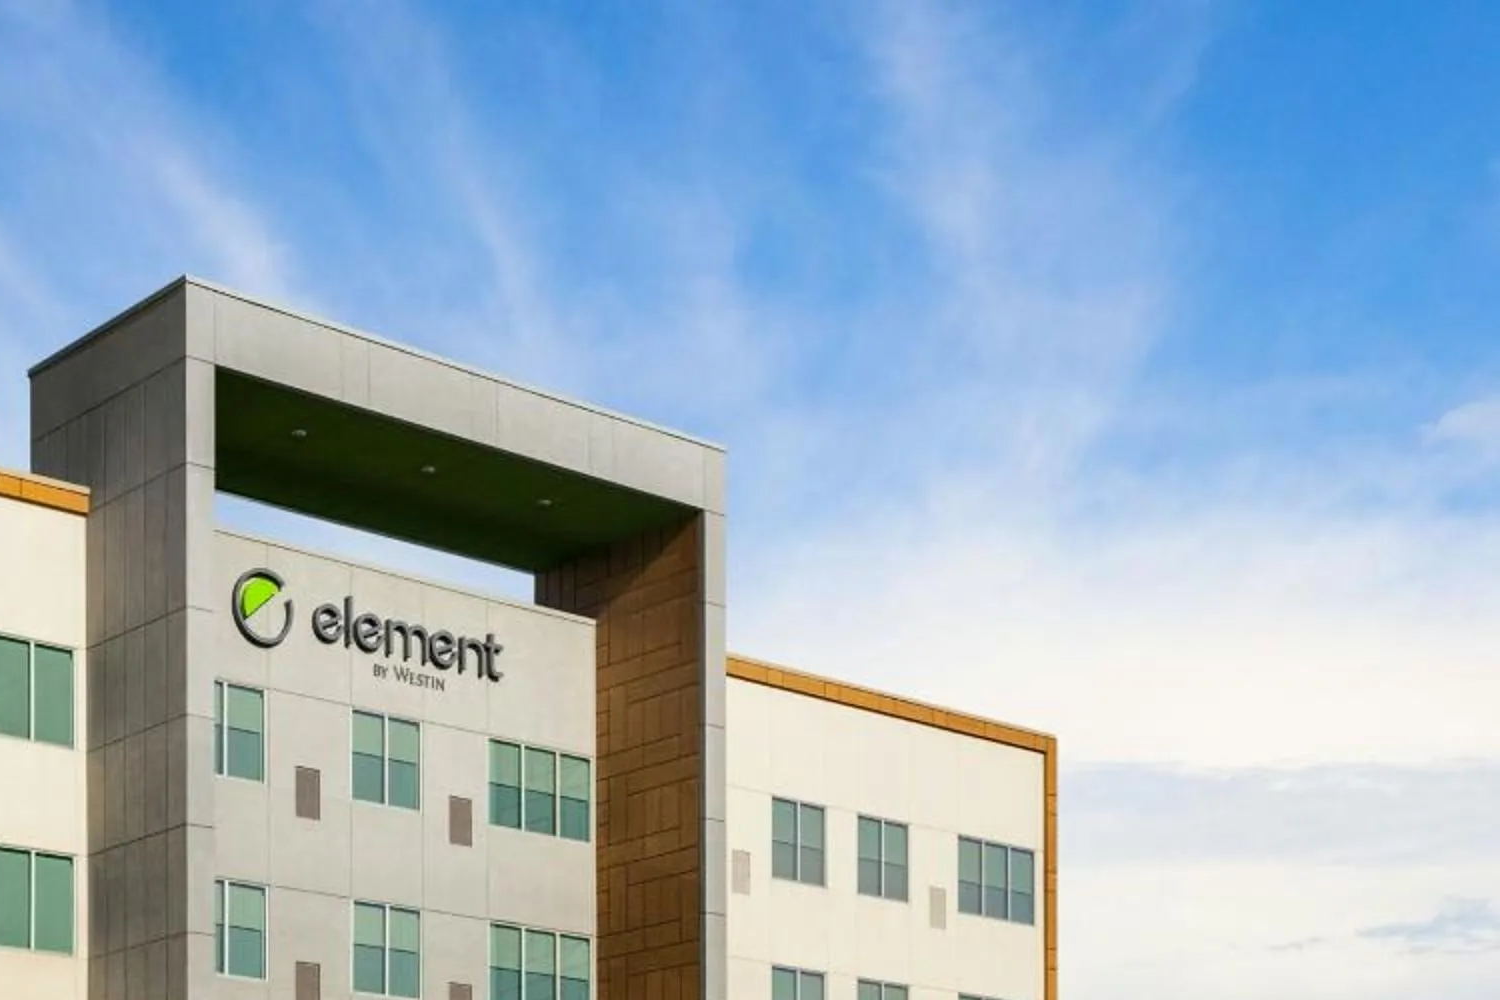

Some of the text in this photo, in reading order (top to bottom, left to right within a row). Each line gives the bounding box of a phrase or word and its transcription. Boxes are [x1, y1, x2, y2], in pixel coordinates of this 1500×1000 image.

[311, 597, 504, 682] element
[373, 664, 446, 692] BY WESTIN
